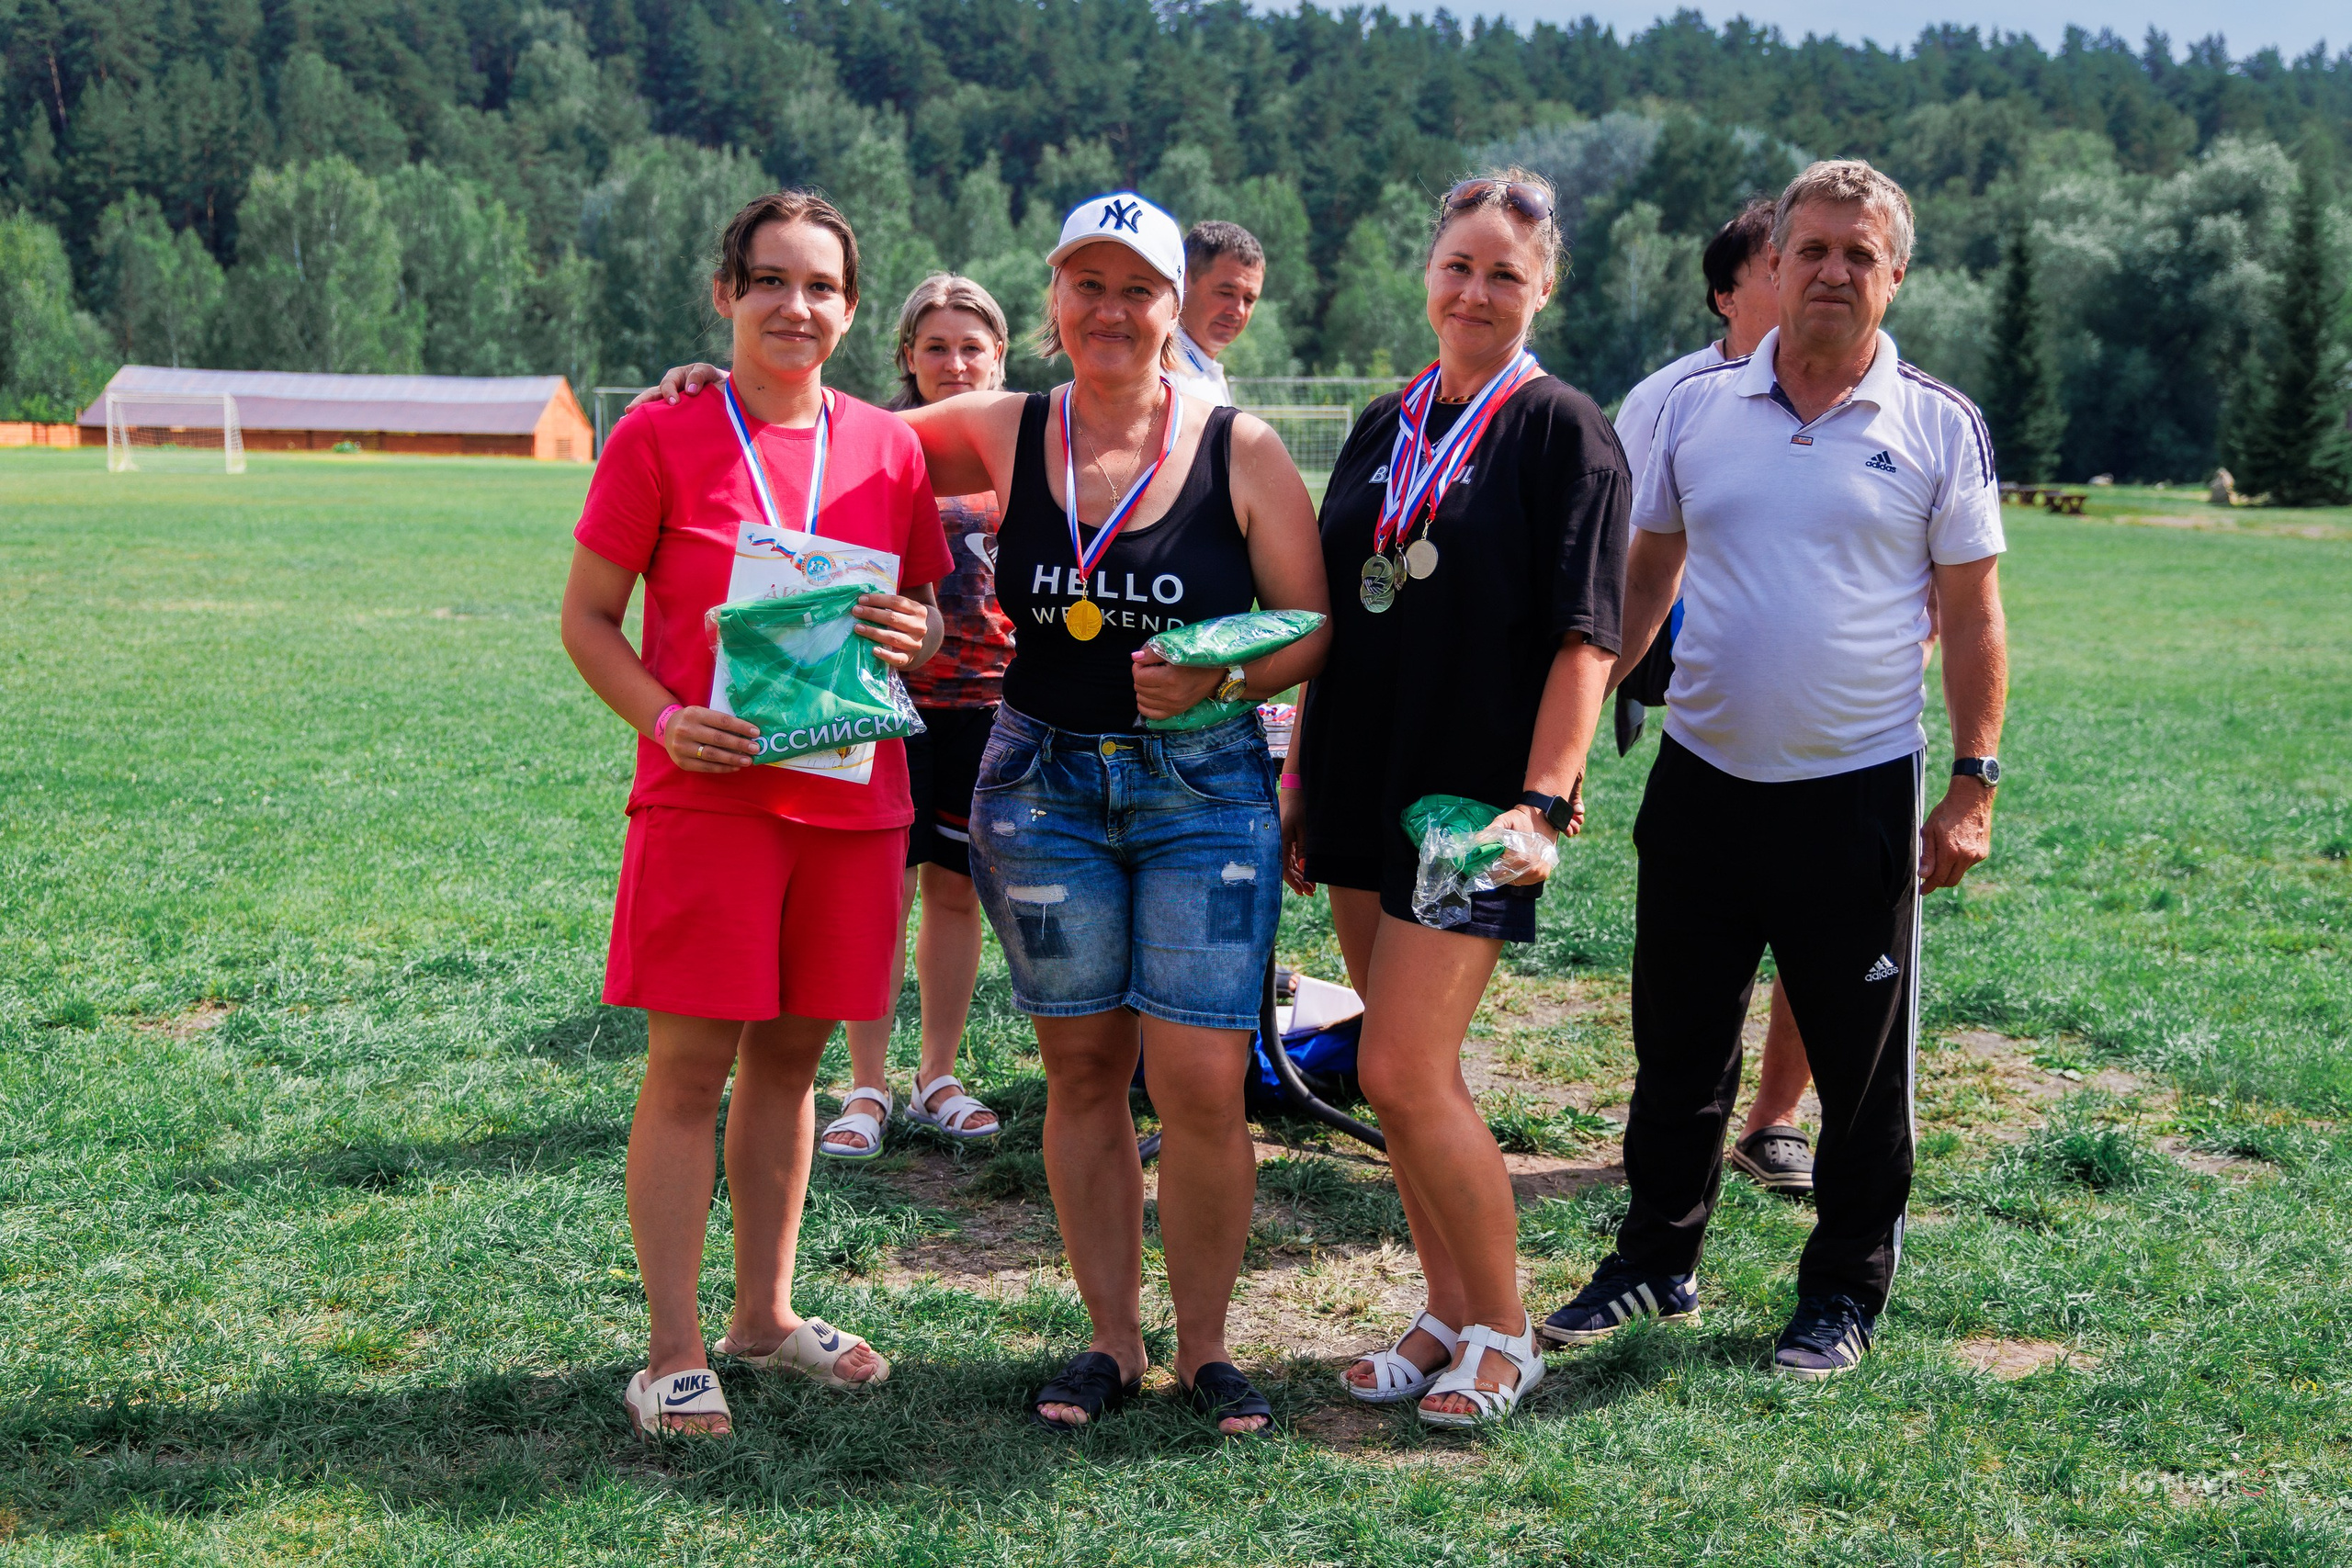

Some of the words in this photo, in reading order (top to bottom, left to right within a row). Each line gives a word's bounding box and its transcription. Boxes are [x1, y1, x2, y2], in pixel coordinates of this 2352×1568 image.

[1099, 199, 1143, 233] NY
[1865, 459, 1896, 473] adidas
[1032, 565, 1183, 604] HELLO
[1865, 966, 1899, 981] adidas
[673, 1375, 711, 1394] NIKE
